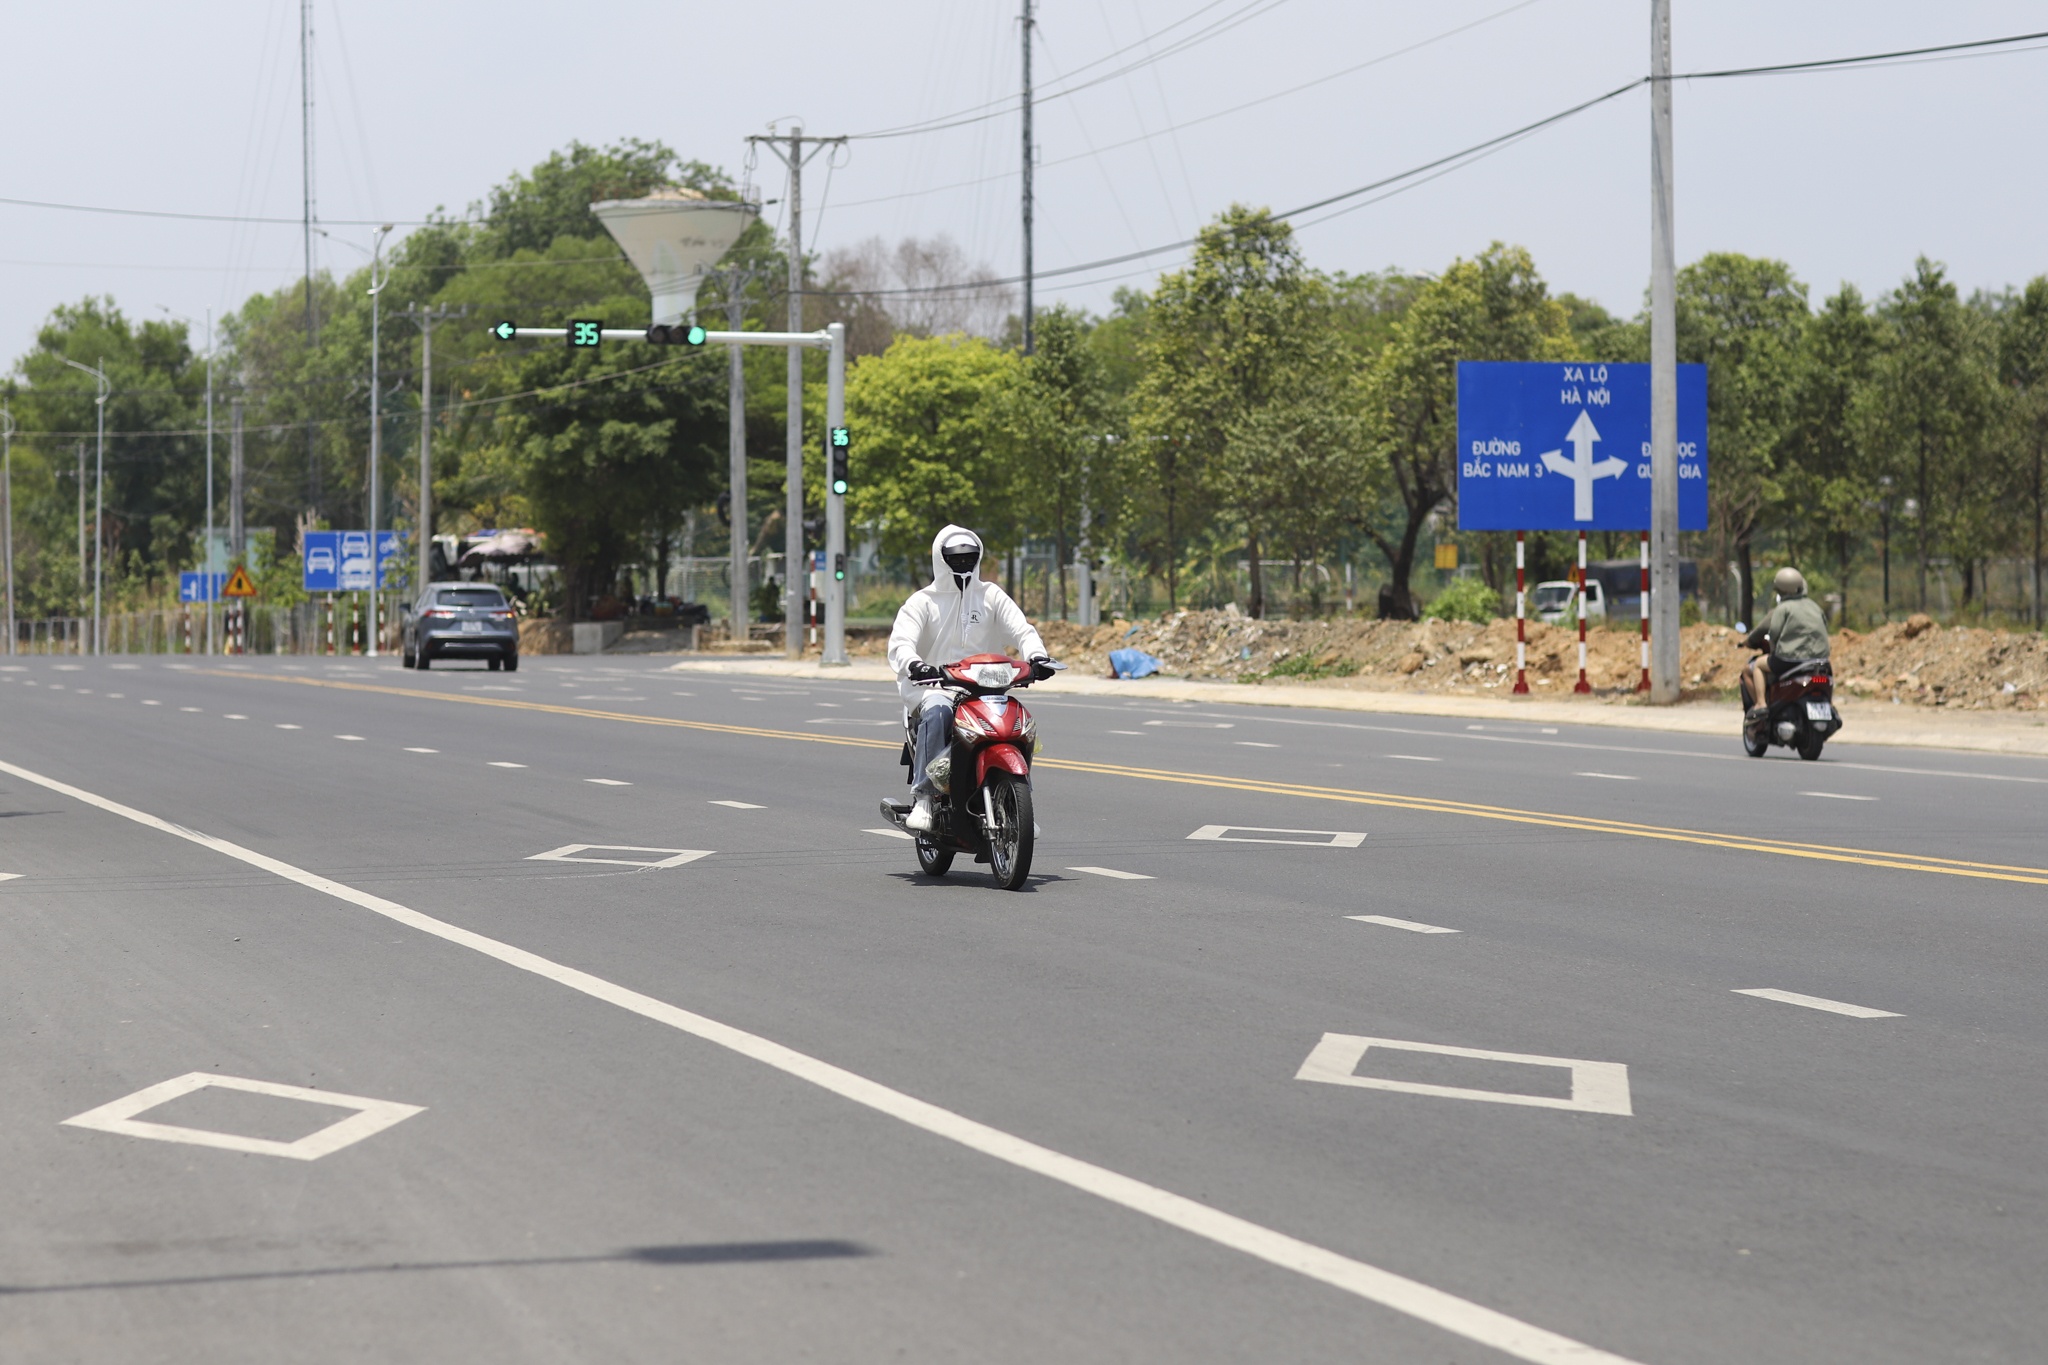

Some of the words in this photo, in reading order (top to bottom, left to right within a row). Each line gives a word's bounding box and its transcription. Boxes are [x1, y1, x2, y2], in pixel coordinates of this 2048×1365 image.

[574, 322, 599, 345] 35
[1563, 366, 1585, 382] XA
[1590, 364, 1608, 385] LỘ
[1561, 385, 1582, 404] HÀ
[1587, 387, 1610, 408] NỘI
[833, 429, 849, 446] 35
[1472, 436, 1521, 456] ĐƯỜNG
[1463, 456, 1491, 478] BẮC
[1497, 463, 1529, 478] NAM
[1534, 463, 1543, 478] 3
[1679, 463, 1702, 479] GIA
